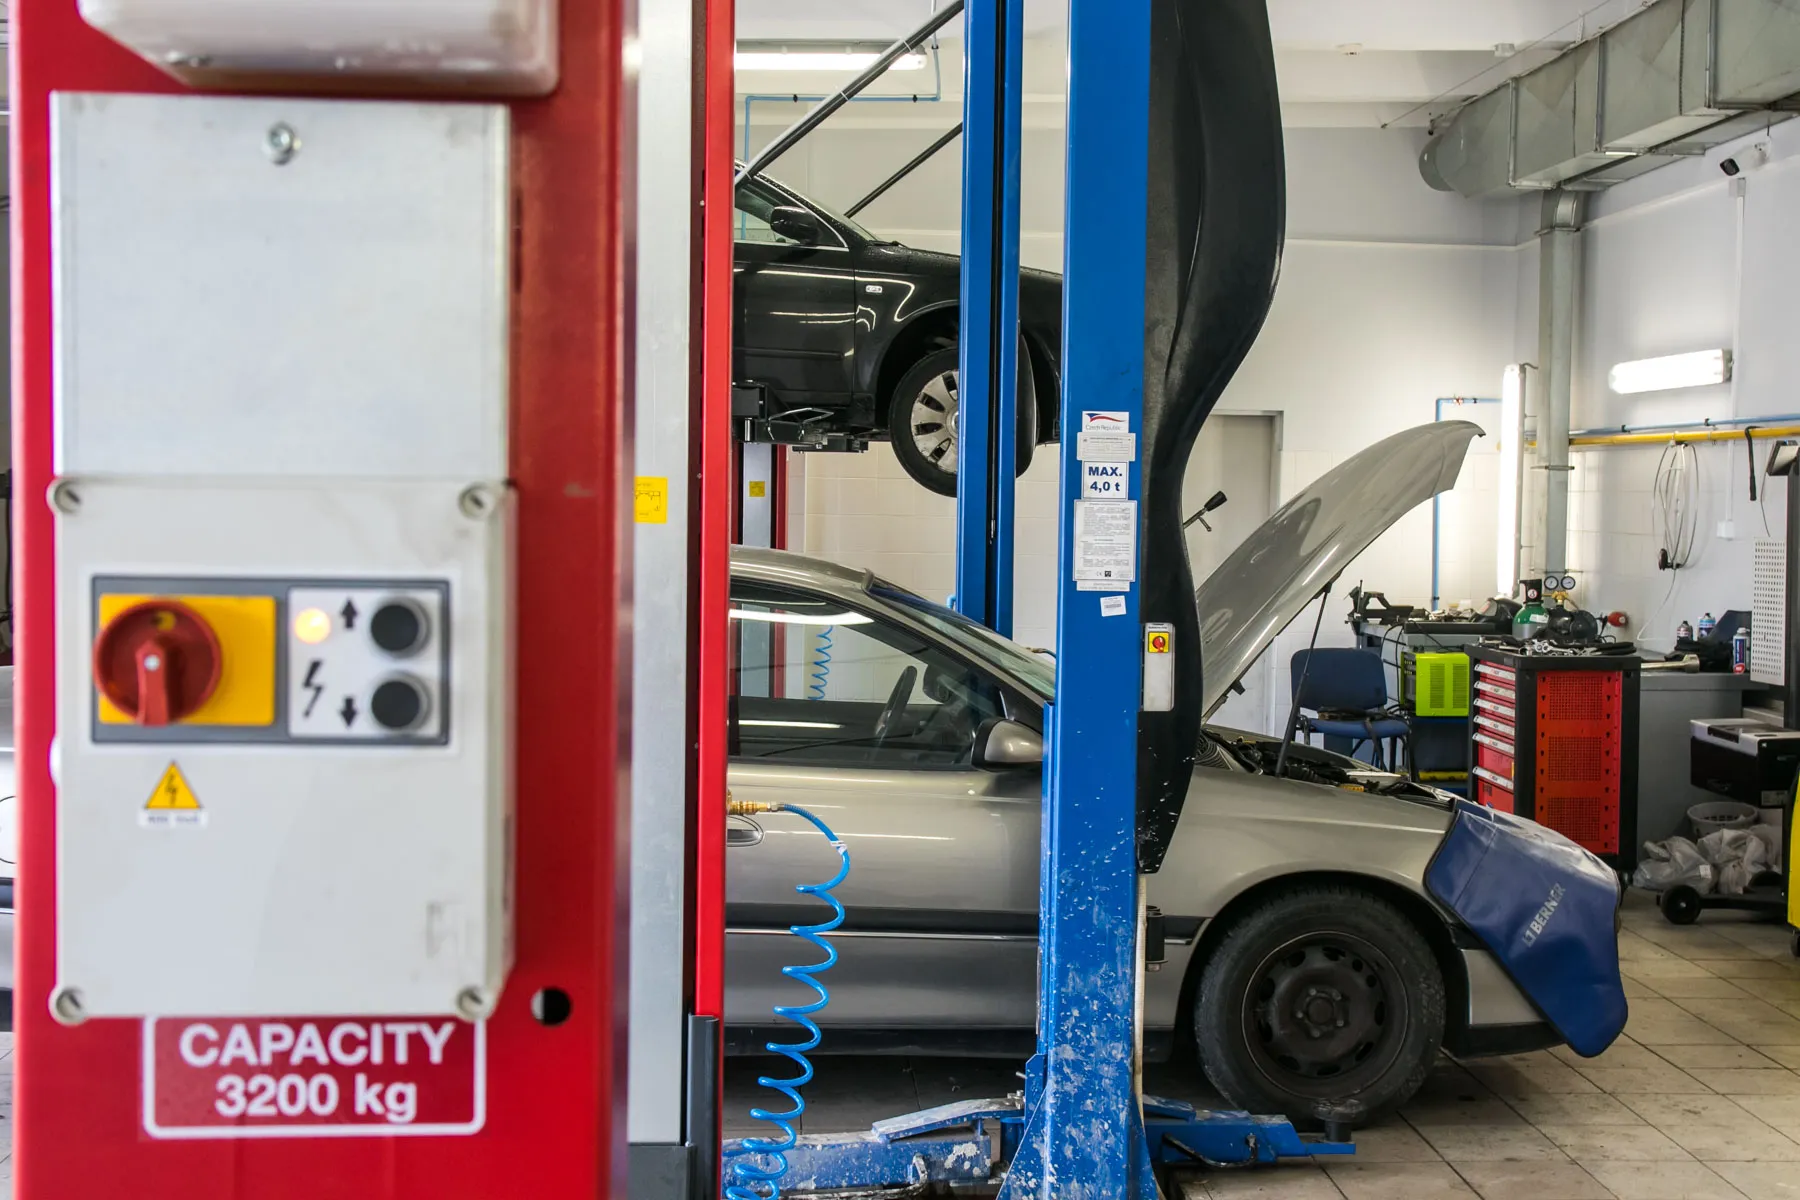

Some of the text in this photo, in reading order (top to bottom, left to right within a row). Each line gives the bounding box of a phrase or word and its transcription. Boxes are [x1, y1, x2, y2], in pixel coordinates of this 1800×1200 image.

[1088, 466, 1123, 477] MAX.
[1090, 481, 1121, 493] 4,0 t
[1530, 883, 1566, 934] BERNER
[180, 1023, 456, 1067] CAPACITY
[214, 1074, 418, 1123] 3200 kg
